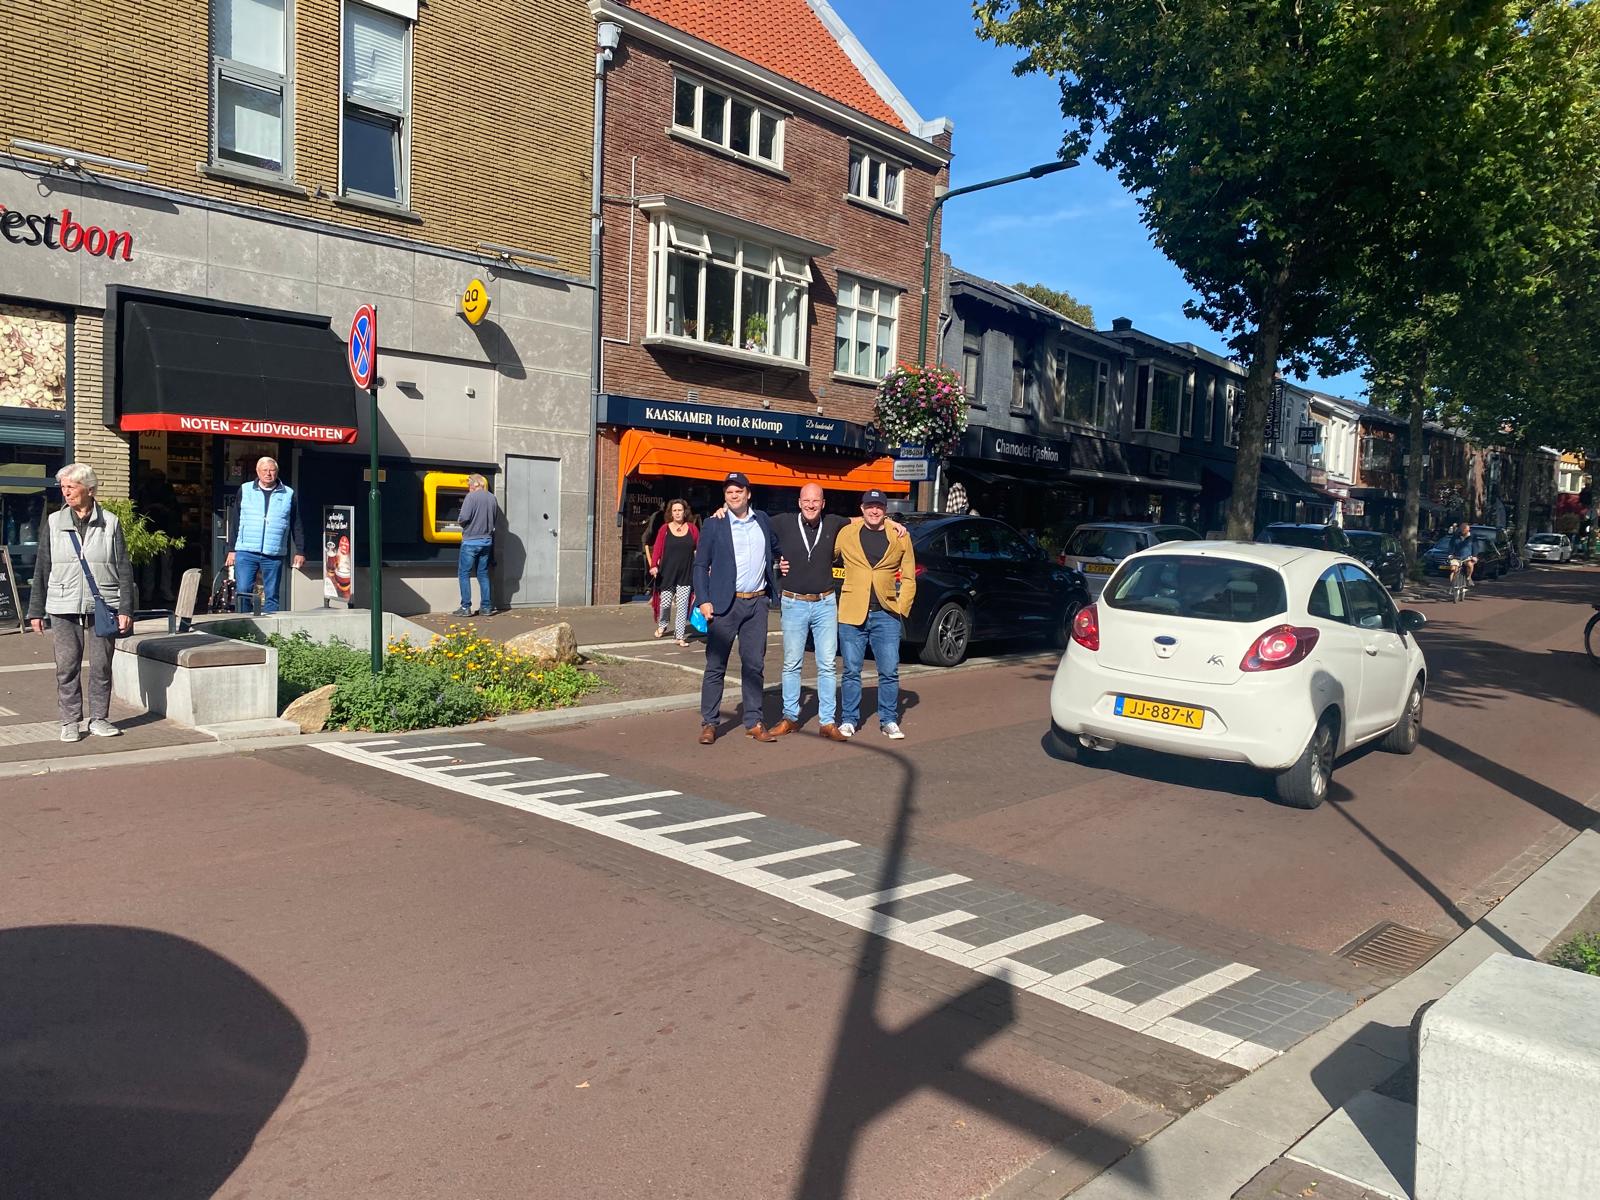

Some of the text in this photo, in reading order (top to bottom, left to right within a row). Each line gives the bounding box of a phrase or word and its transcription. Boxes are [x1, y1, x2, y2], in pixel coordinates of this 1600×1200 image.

[180, 417, 230, 432] NOTEN
[241, 422, 343, 440] ZUIDVRUCHTEN
[645, 407, 783, 434] KAASKAMER Hooi & Klomp
[995, 438, 1059, 462] Chanodet Fashion
[1130, 702, 1194, 724] JJ-887-K
